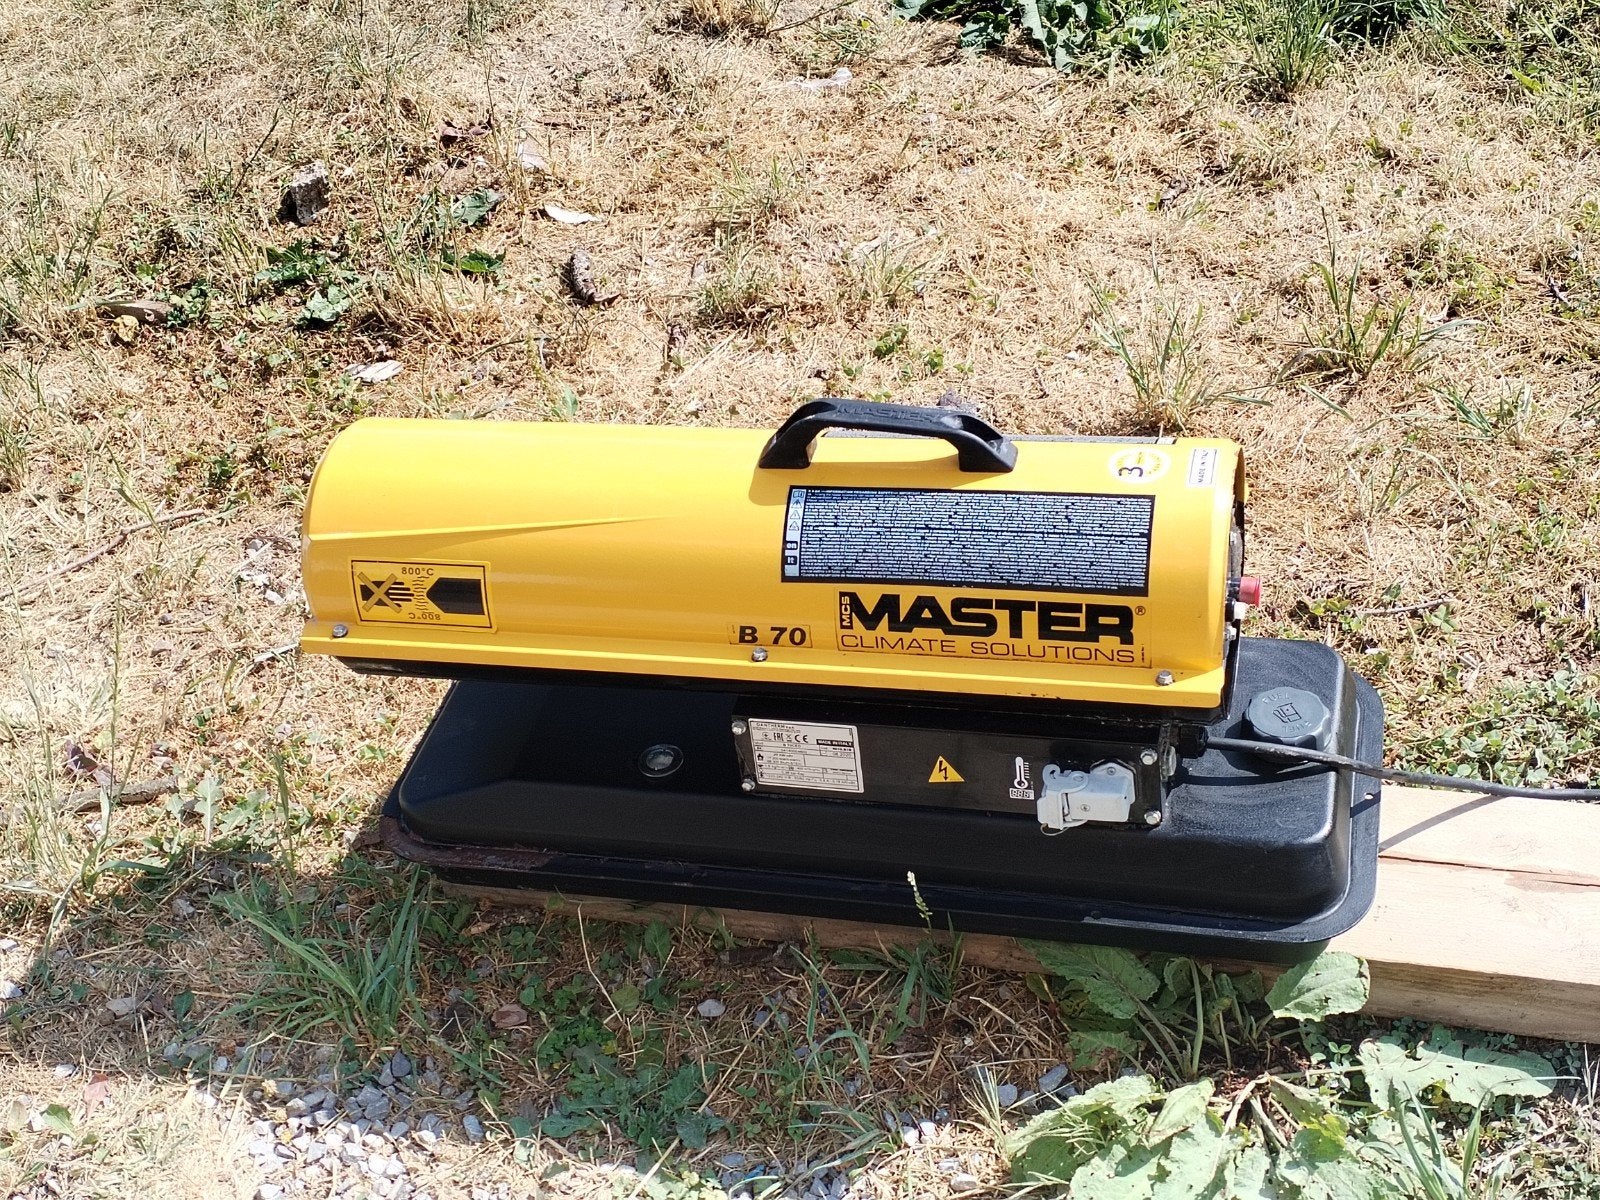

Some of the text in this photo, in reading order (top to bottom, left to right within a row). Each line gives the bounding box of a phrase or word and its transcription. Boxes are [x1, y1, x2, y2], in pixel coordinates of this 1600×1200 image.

[401, 567, 434, 576] 800°C
[841, 595, 851, 626] MCS
[849, 591, 1134, 646] MASTER
[738, 625, 759, 645] B
[770, 626, 807, 646] 70
[840, 634, 957, 654] CLIMATE
[970, 641, 1135, 663] SOLUTIONS
